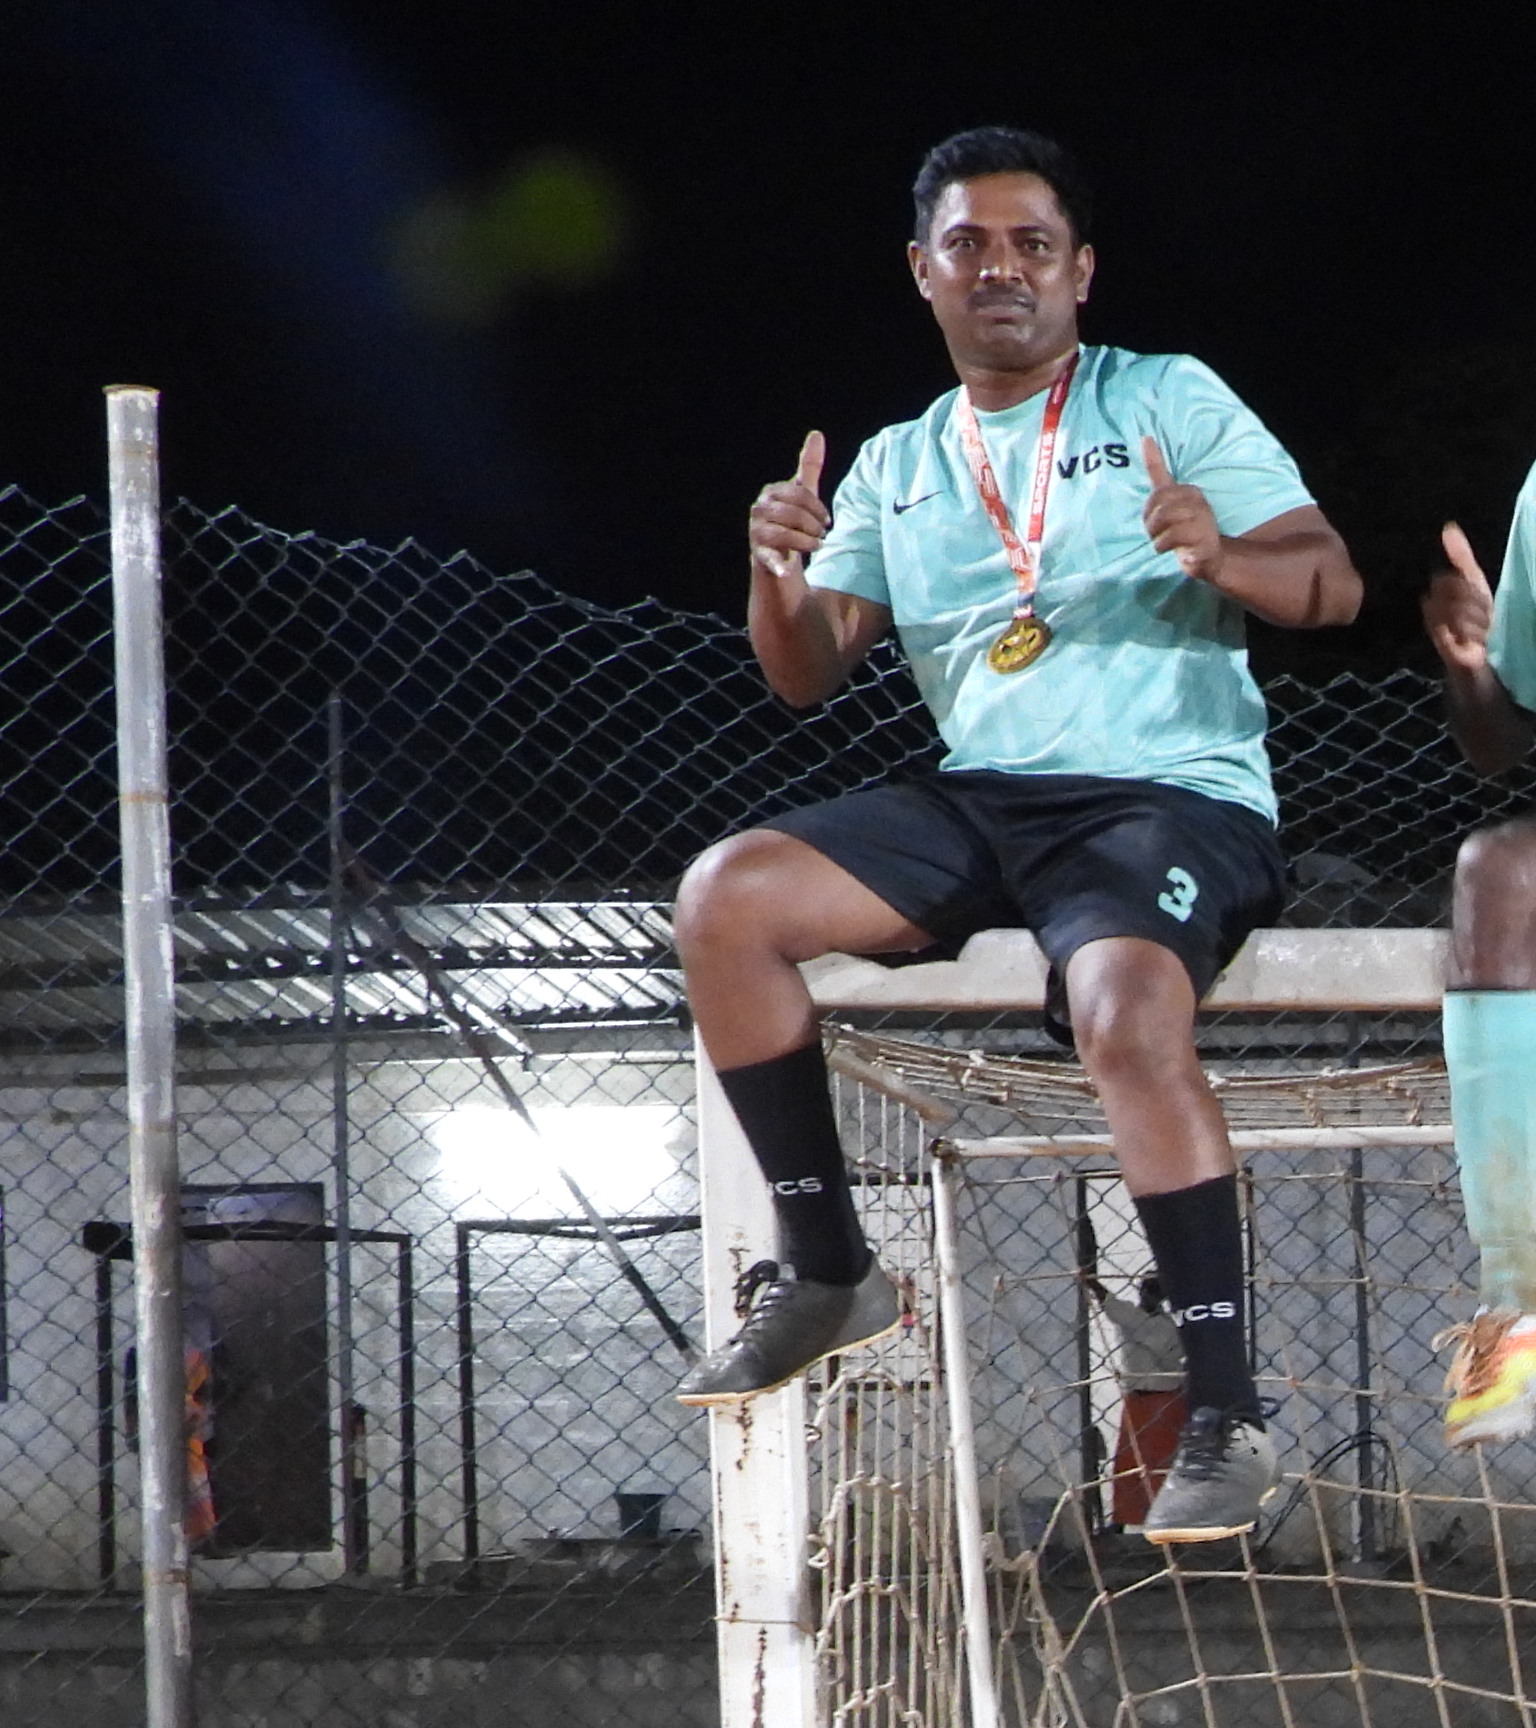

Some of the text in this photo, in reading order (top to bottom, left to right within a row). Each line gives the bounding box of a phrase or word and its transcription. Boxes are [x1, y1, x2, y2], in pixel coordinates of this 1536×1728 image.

[1057, 443, 1130, 479] VCS
[1158, 866, 1199, 922] 3
[768, 1177, 823, 1195] CS
[1161, 1298, 1236, 1328] VCS
